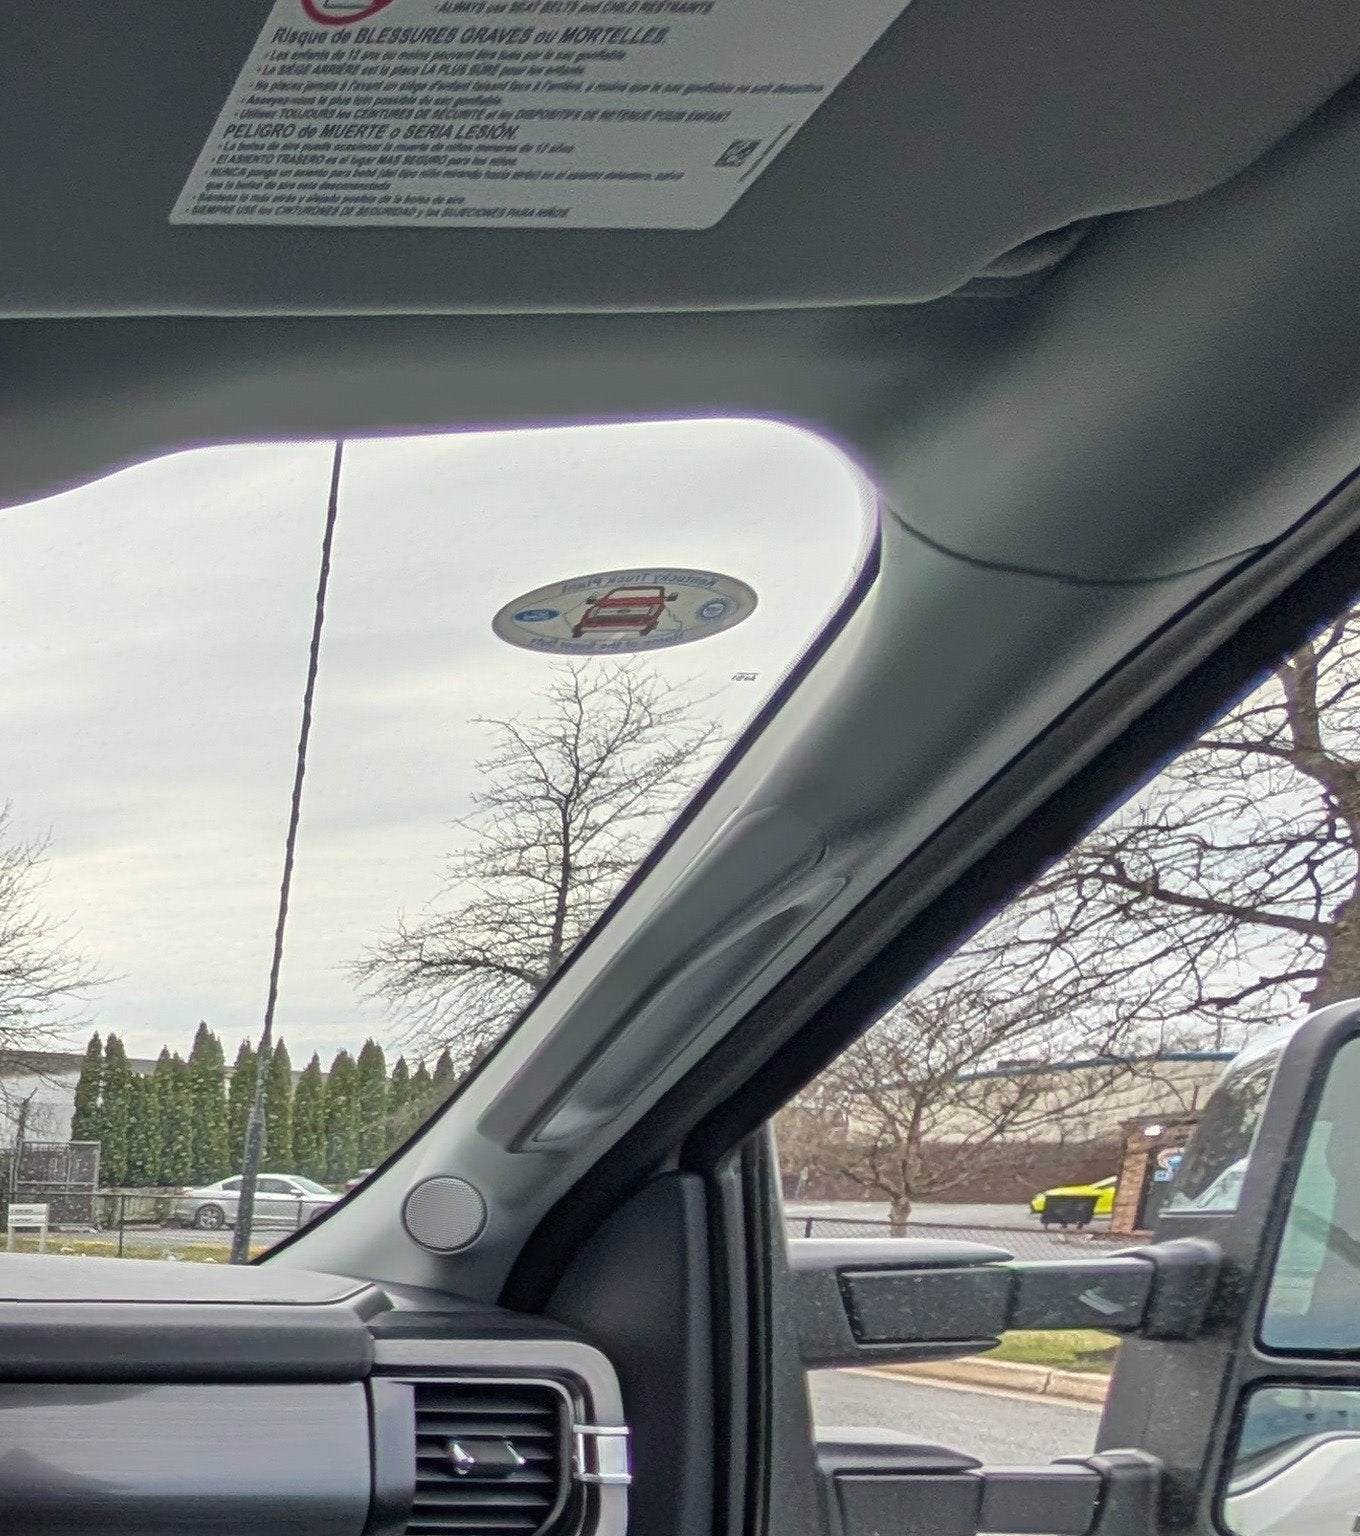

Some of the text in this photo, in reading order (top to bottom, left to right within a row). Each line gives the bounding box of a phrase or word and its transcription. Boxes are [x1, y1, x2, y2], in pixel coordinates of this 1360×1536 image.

[273, 27, 327, 47] Risque
[330, 28, 352, 43] de
[354, 27, 460, 44] BLESSURES
[459, 27, 537, 44] GRAVES
[534, 32, 560, 43] ou
[223, 123, 296, 138] PELIGRO
[297, 124, 318, 137] de
[318, 123, 388, 139] MUERTE
[401, 124, 453, 140] SERIA
